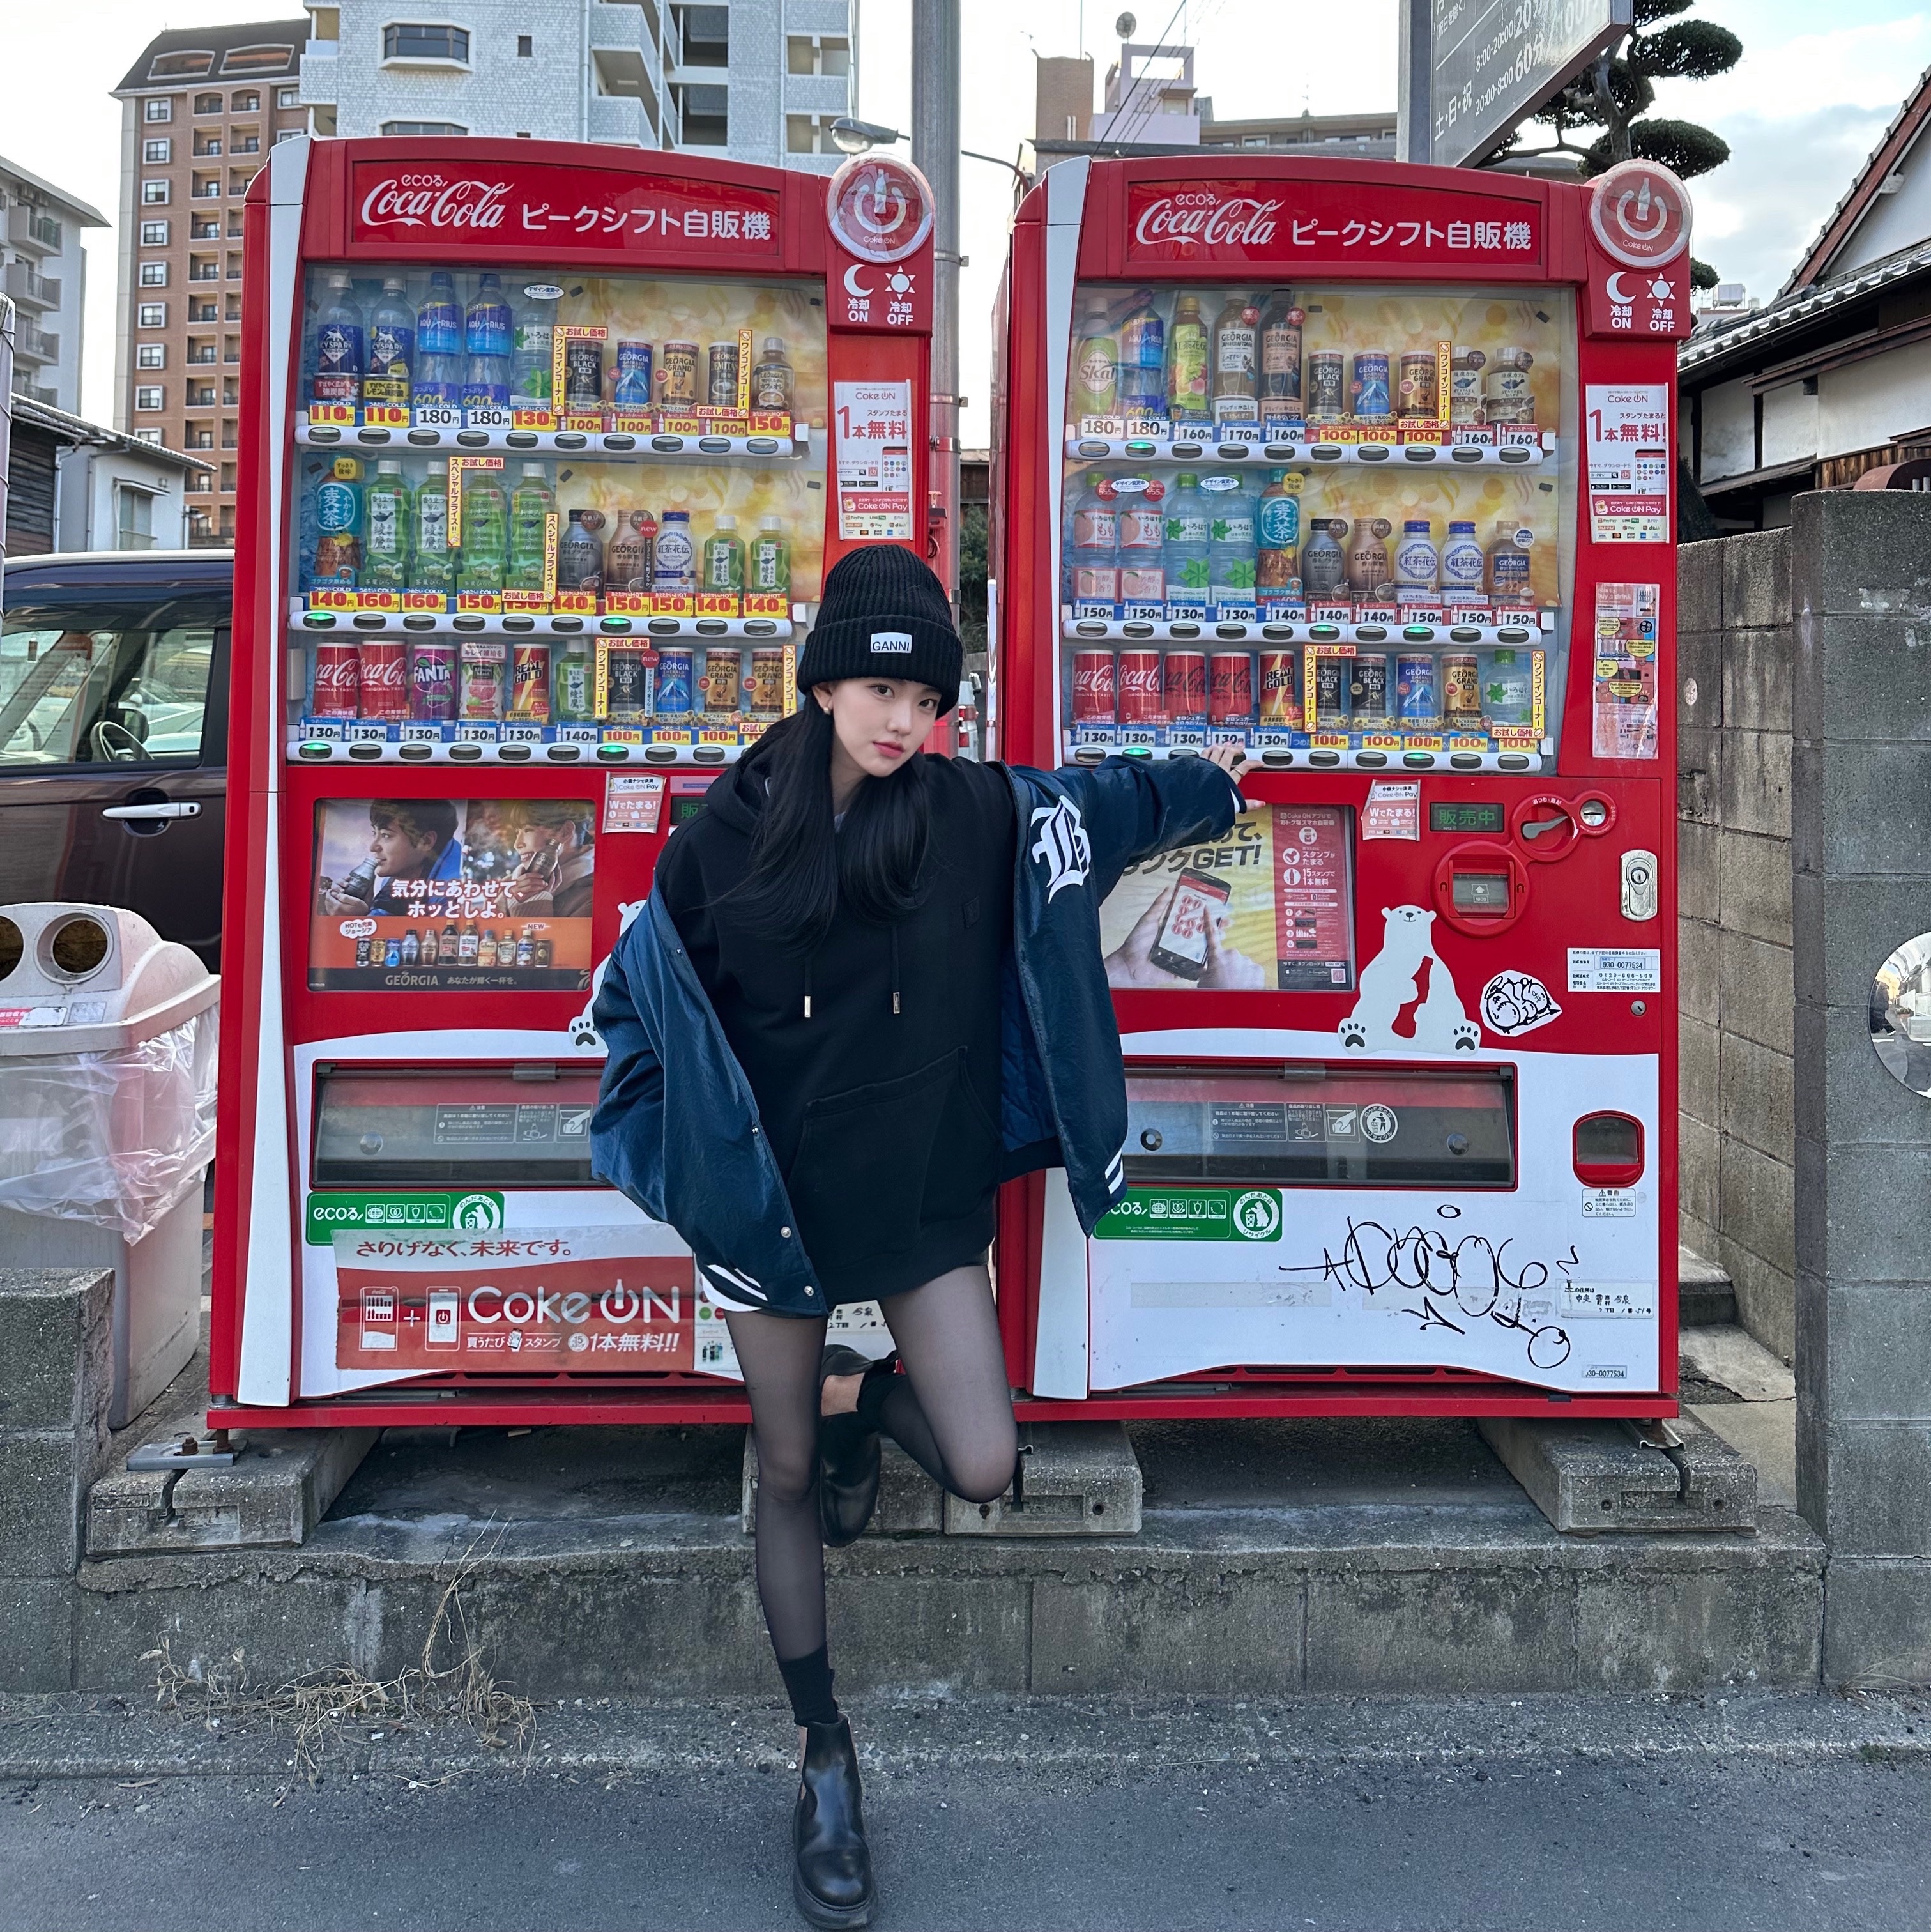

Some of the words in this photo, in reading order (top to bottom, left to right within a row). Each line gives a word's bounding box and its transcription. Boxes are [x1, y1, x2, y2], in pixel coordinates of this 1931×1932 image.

[1476, 20, 1514, 72] 8:00-20:00
[1476, 66, 1513, 117] 20:00-8:00
[361, 180, 515, 229] Coca-Cola
[522, 203, 772, 241] ピークシフト自販機
[1136, 198, 1286, 247] Coca-Cola
[1292, 218, 1532, 250] ピークシフト自販機
[883, 236, 896, 245] ON
[1642, 243, 1654, 252] ON
[847, 298, 870, 310] 冷却
[889, 302, 912, 314] 冷却
[848, 310, 868, 322] ON
[1610, 305, 1633, 317] 冷却
[1652, 308, 1673, 319] 冷却
[420, 316, 457, 329] AQUARIUS
[468, 316, 505, 330] AQUARIUS
[887, 314, 913, 326] OFF
[1611, 317, 1631, 329] ON
[1649, 320, 1675, 332] OFF
[565, 328, 606, 337] お試し価格
[618, 352, 650, 364] GEORGIA
[665, 355, 696, 365] GEORGIA
[573, 360, 597, 369] BLACK
[668, 364, 692, 372] GRAND
[554, 338, 563, 404] ワンコインコーナー
[739, 342, 749, 407] ワンコインコーナー
[1439, 354, 1449, 418] ワンコインコーナー
[855, 392, 880, 400] Coke
[881, 391, 896, 400] ON
[1607, 395, 1632, 403] Coke
[1633, 394, 1648, 403] ON
[311, 405, 355, 422] 110円
[366, 407, 409, 423] 110円
[420, 410, 459, 424] 180円
[471, 411, 510, 425] 180円
[698, 408, 738, 417] お試し価格
[514, 411, 556, 426] 130円
[749, 417, 789, 431] 150円
[837, 405, 907, 440] 1本無料
[570, 420, 601, 431] 100円
[620, 421, 651, 432] 100円
[668, 422, 698, 433] 100円
[1084, 420, 1122, 434] 180円
[1130, 422, 1167, 436] 180円
[1400, 420, 1439, 429] お試し価格
[1182, 429, 1212, 440] 160円
[1229, 430, 1259, 440] 170円
[1274, 430, 1304, 440] 160円
[1322, 430, 1356, 441] 100円
[1361, 431, 1396, 442] 100円
[1406, 432, 1440, 442] 100円
[461, 459, 502, 468] お試し価格
[323, 487, 342, 526] 麦茶
[878, 502, 891, 510] ON
[892, 502, 908, 512] Pay
[1631, 504, 1645, 513] ON
[1645, 505, 1661, 514] Pay
[657, 544, 690, 554] 紅茶花伝
[1403, 556, 1437, 566] 紅茶花伝
[311, 592, 355, 607] 140円
[356, 593, 399, 608] 160円
[403, 594, 446, 608] 160円
[503, 592, 544, 601] お試し価格
[459, 595, 501, 610] 150円
[607, 597, 649, 612] 150円
[696, 598, 738, 613] 140円
[745, 598, 787, 613] 140円
[1083, 607, 1113, 618] 150円
[1133, 608, 1162, 618] 150円
[1175, 609, 1204, 619] 130円
[1226, 610, 1255, 620] 130円
[1275, 610, 1304, 620] 140円
[1319, 610, 1349, 620] 140円
[1364, 611, 1394, 622] 140円
[1412, 612, 1442, 623] 150円
[1506, 614, 1536, 624] 150円
[607, 639, 648, 649] お試し価格
[873, 641, 910, 652] GANNI
[1316, 647, 1355, 656] お試し価格
[514, 660, 542, 675] REAL
[413, 664, 452, 683] FANTA
[514, 671, 542, 685] GOLD
[784, 657, 794, 718] ワンコインコーナ
[1306, 657, 1315, 721] ワンコインコーナー
[1533, 663, 1543, 726] ワンコインコーナー
[354, 728, 386, 740] 130円
[409, 729, 441, 740] 130円
[464, 730, 495, 741] 130円
[565, 731, 597, 742] 140円
[654, 731, 689, 742] 100円
[703, 732, 735, 742] 100円
[1084, 732, 1114, 742] 130円
[1493, 728, 1533, 737] お試し価格
[1125, 733, 1154, 744] 130円
[1173, 733, 1203, 744] 130円
[1258, 735, 1287, 746] 130円
[1313, 735, 1347, 746] 100円
[1406, 737, 1440, 747] 100円
[1452, 738, 1486, 747] 100円
[1369, 808, 1416, 817] Wでたまる!
[1439, 809, 1495, 826] 販売中
[391, 879, 524, 898] 気分にあわせて、
[408, 901, 505, 919] ホッとしよ。
[1603, 961, 1644, 969] 930-0077534
[385, 970, 439, 986] GEORGIA
[356, 1239, 572, 1257] さりげなく、未来です。
[467, 1285, 591, 1324] Coke
[599, 1278, 681, 1324] ON
[466, 1335, 506, 1349] 買うたび
[524, 1337, 562, 1348] スタンプ
[590, 1333, 680, 1353] 1本無料!!
